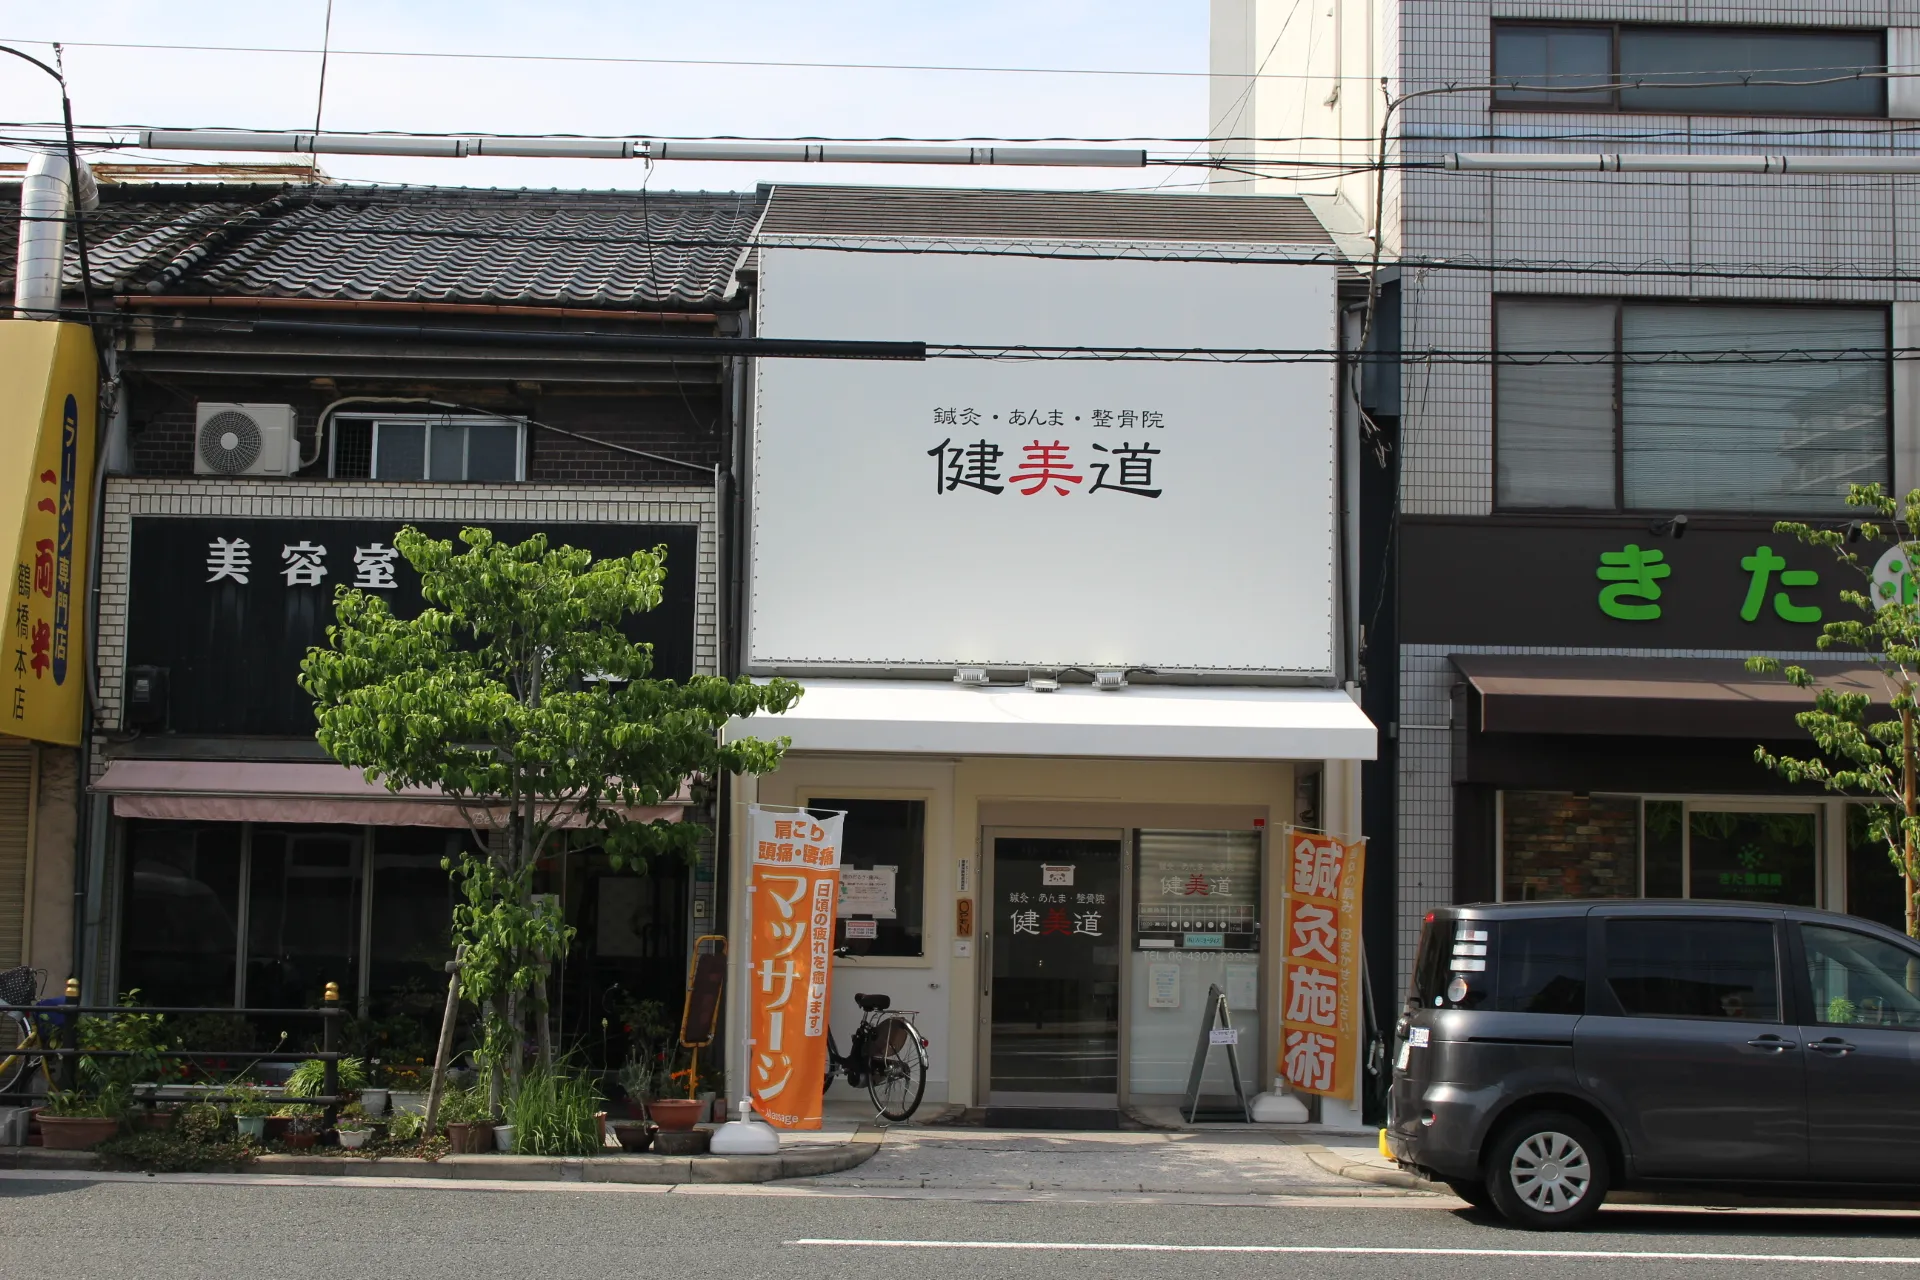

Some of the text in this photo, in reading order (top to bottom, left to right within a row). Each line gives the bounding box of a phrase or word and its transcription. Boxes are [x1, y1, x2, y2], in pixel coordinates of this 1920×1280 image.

[933, 407, 1165, 429] 鍼灸・あんま・整骨院
[927, 437, 1163, 499] 健美道
[54, 416, 75, 661] ラーメン専門店
[206, 537, 400, 589] 美容室
[12, 563, 31, 722] 鶴橋本店
[758, 841, 835, 866] 頭痛・腰痛
[775, 820, 825, 842] 肩こり
[1160, 874, 1233, 897] 健美道
[1010, 907, 1103, 937] 健美道
[757, 873, 808, 1101] マッサージ
[808, 883, 831, 1035] 日頃の疲れを癒します。
[1285, 839, 1344, 1091] 鍼灸施術
